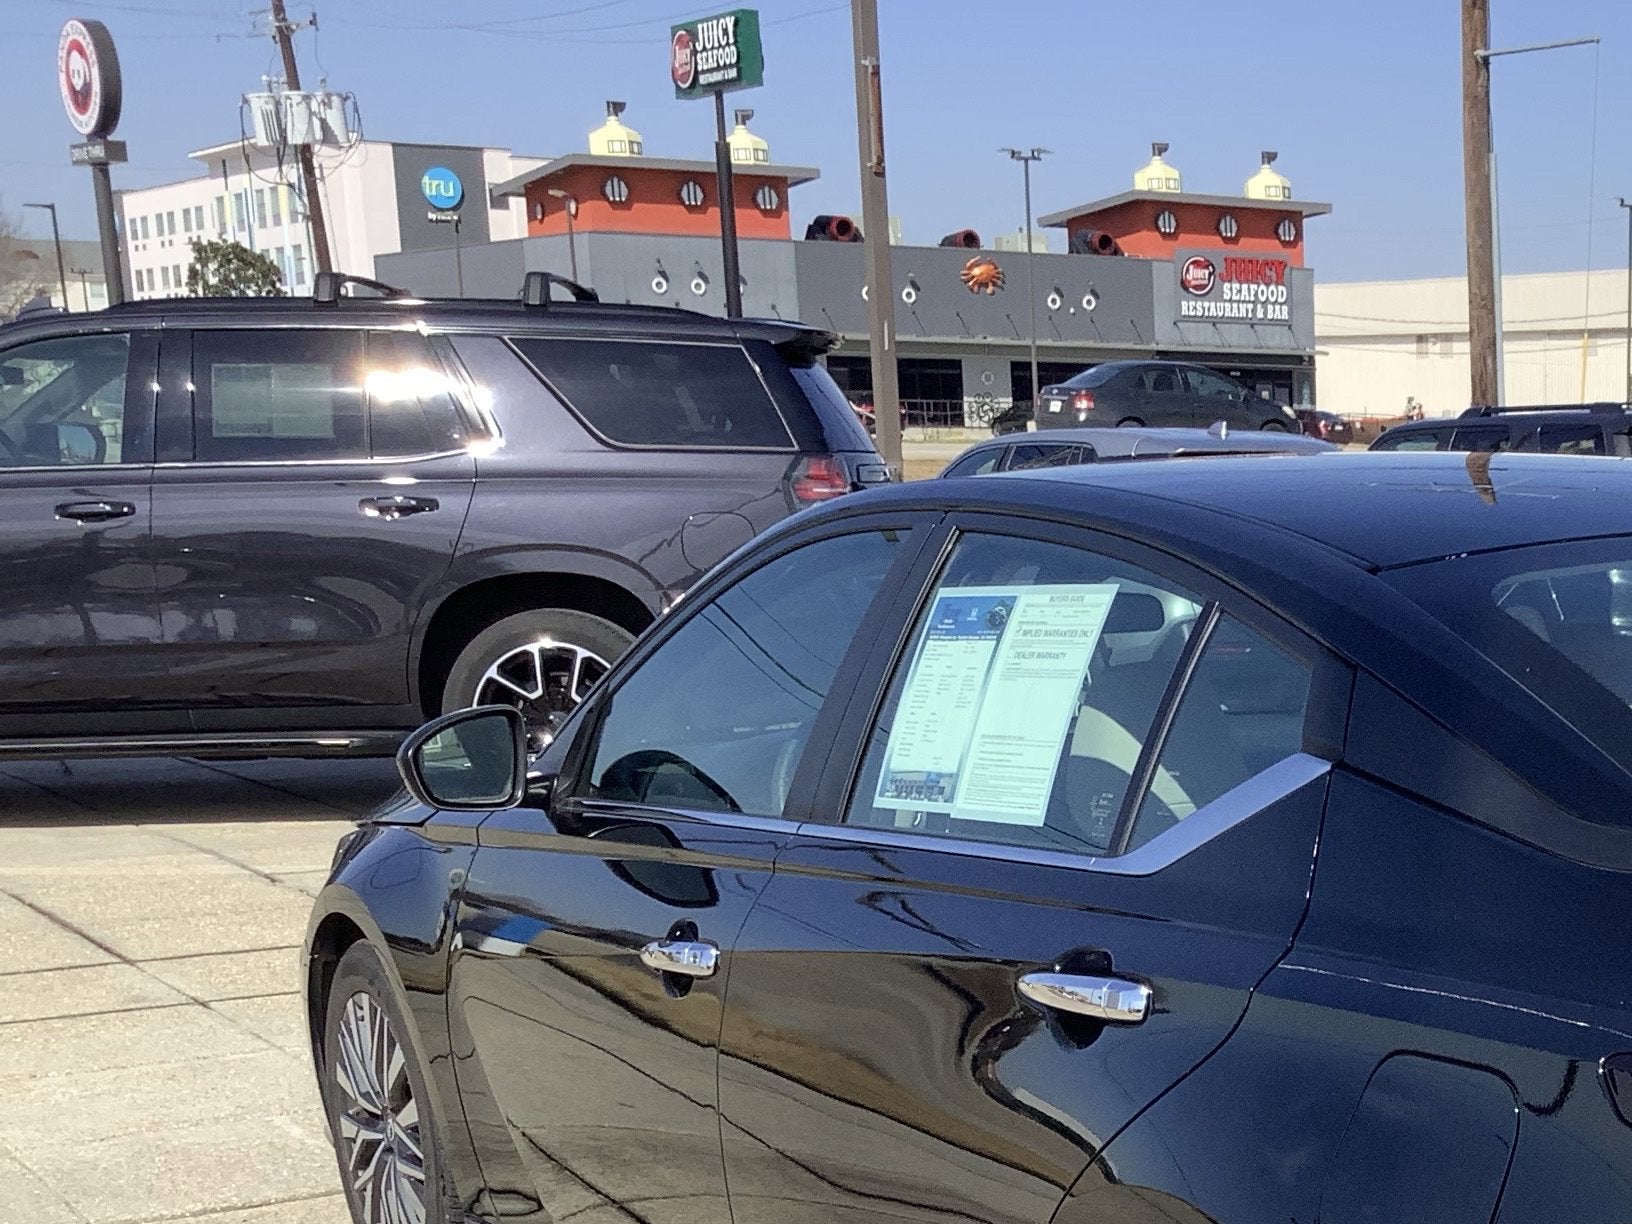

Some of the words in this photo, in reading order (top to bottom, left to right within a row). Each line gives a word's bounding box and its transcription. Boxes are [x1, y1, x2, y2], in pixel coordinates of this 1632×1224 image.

[695, 16, 735, 51] JUICY
[696, 45, 737, 71] SEAFOOD
[422, 175, 455, 197] tru
[1219, 256, 1288, 286] JUICY
[1223, 282, 1287, 303] SEAFOOD
[1181, 300, 1255, 318] RESTAURANT
[1256, 304, 1264, 319] &
[1267, 304, 1289, 320] BAR
